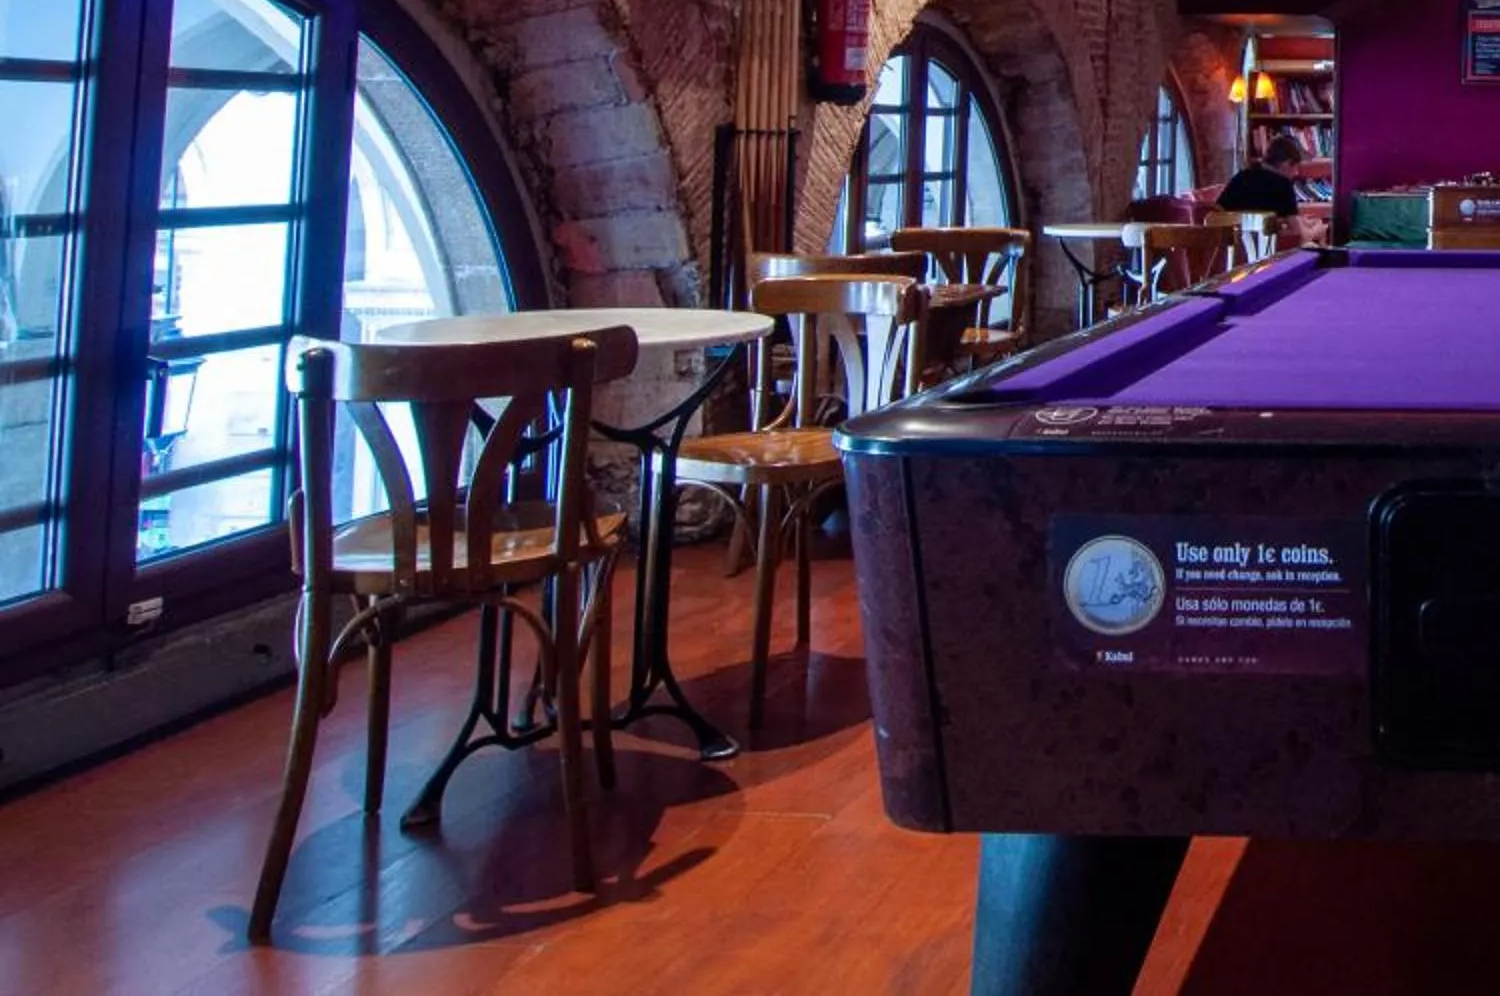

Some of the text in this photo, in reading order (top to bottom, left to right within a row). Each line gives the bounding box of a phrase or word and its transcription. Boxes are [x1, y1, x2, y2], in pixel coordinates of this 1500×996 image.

[1175, 542, 1335, 567] Use only 1€ coins.
[1185, 570, 1201, 583] you
[1175, 597, 1199, 612] Usa
[1202, 596, 1229, 612] sólo
[1231, 597, 1287, 613] monedas
[1289, 598, 1306, 613] de
